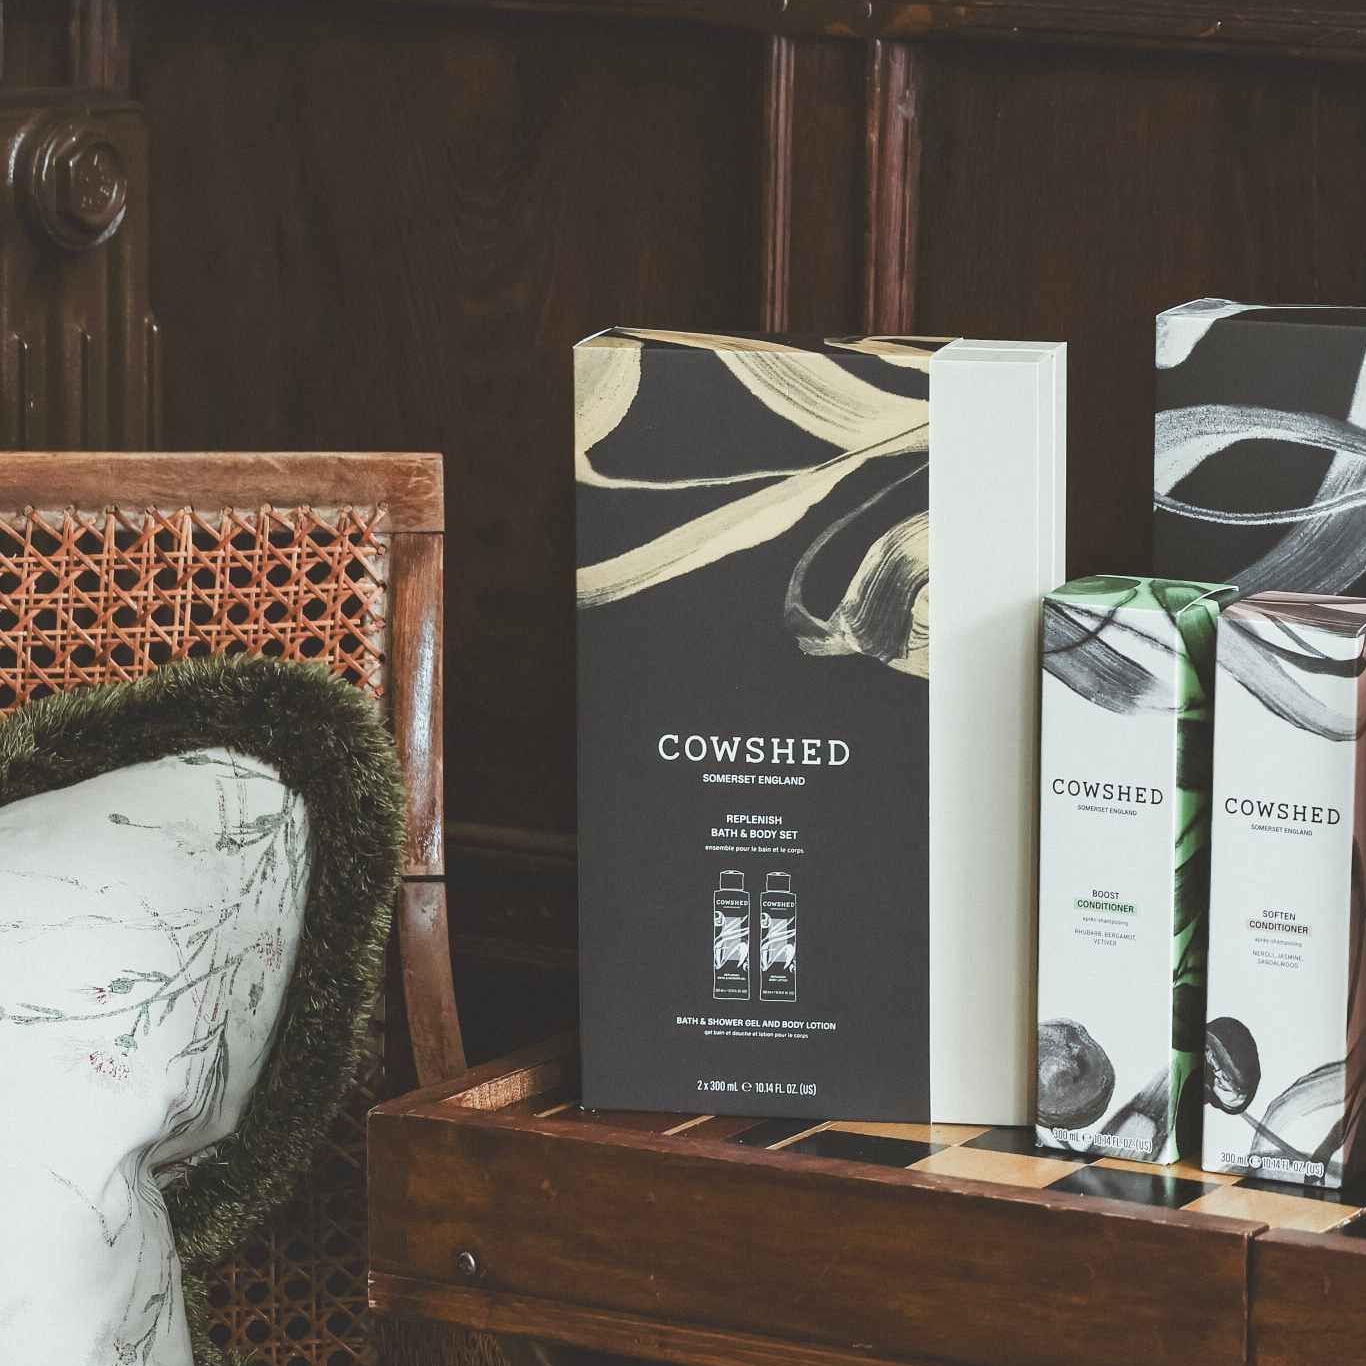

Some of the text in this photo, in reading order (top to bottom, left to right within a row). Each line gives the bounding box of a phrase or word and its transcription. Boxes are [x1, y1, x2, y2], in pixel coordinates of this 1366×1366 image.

[658, 734, 849, 765] COWSHED
[703, 774, 805, 785] SOMERSET ENGLAND
[1052, 779, 1163, 804] COWSHED
[1078, 805, 1137, 816] SOMERSET ENGLAND
[1225, 798, 1340, 824] COWSHED
[727, 815, 782, 825] REPLENISH
[711, 828, 798, 840] BATH & BODY SET
[1251, 824, 1312, 836] SOMERSET ENGLAND
[736, 845, 750, 853] pour
[1092, 890, 1119, 899] BOOST
[1077, 900, 1134, 913] CONDITIONER
[1262, 910, 1296, 920] SOFTEN
[1250, 921, 1308, 934] CONDITIONER
[1075, 929, 1136, 941] RHUBARB, BERGAMOT,
[1253, 950, 1303, 962] NEROLI, JASMINE,
[1258, 959, 1298, 968] SANDALWOOD
[677, 1017, 698, 1025] BATH
[708, 1018, 743, 1026] SHOWER
[762, 1020, 780, 1028] AND
[806, 1022, 836, 1030] LOTION
[697, 1080, 702, 1090] 2
[710, 1081, 725, 1091] 300
[727, 1082, 738, 1092] mL
[756, 1083, 773, 1093] 10.14
[800, 1083, 816, 1095] (US)
[1053, 1129, 1067, 1140] 300
[1070, 1133, 1079, 1141] mL
[1094, 1135, 1111, 1146] 10.14
[1136, 1139, 1152, 1152] (US)
[1221, 1152, 1235, 1163] 300
[1237, 1156, 1248, 1166] mL
[1262, 1158, 1280, 1169] 10.14
[1306, 1161, 1324, 1175] (US)
